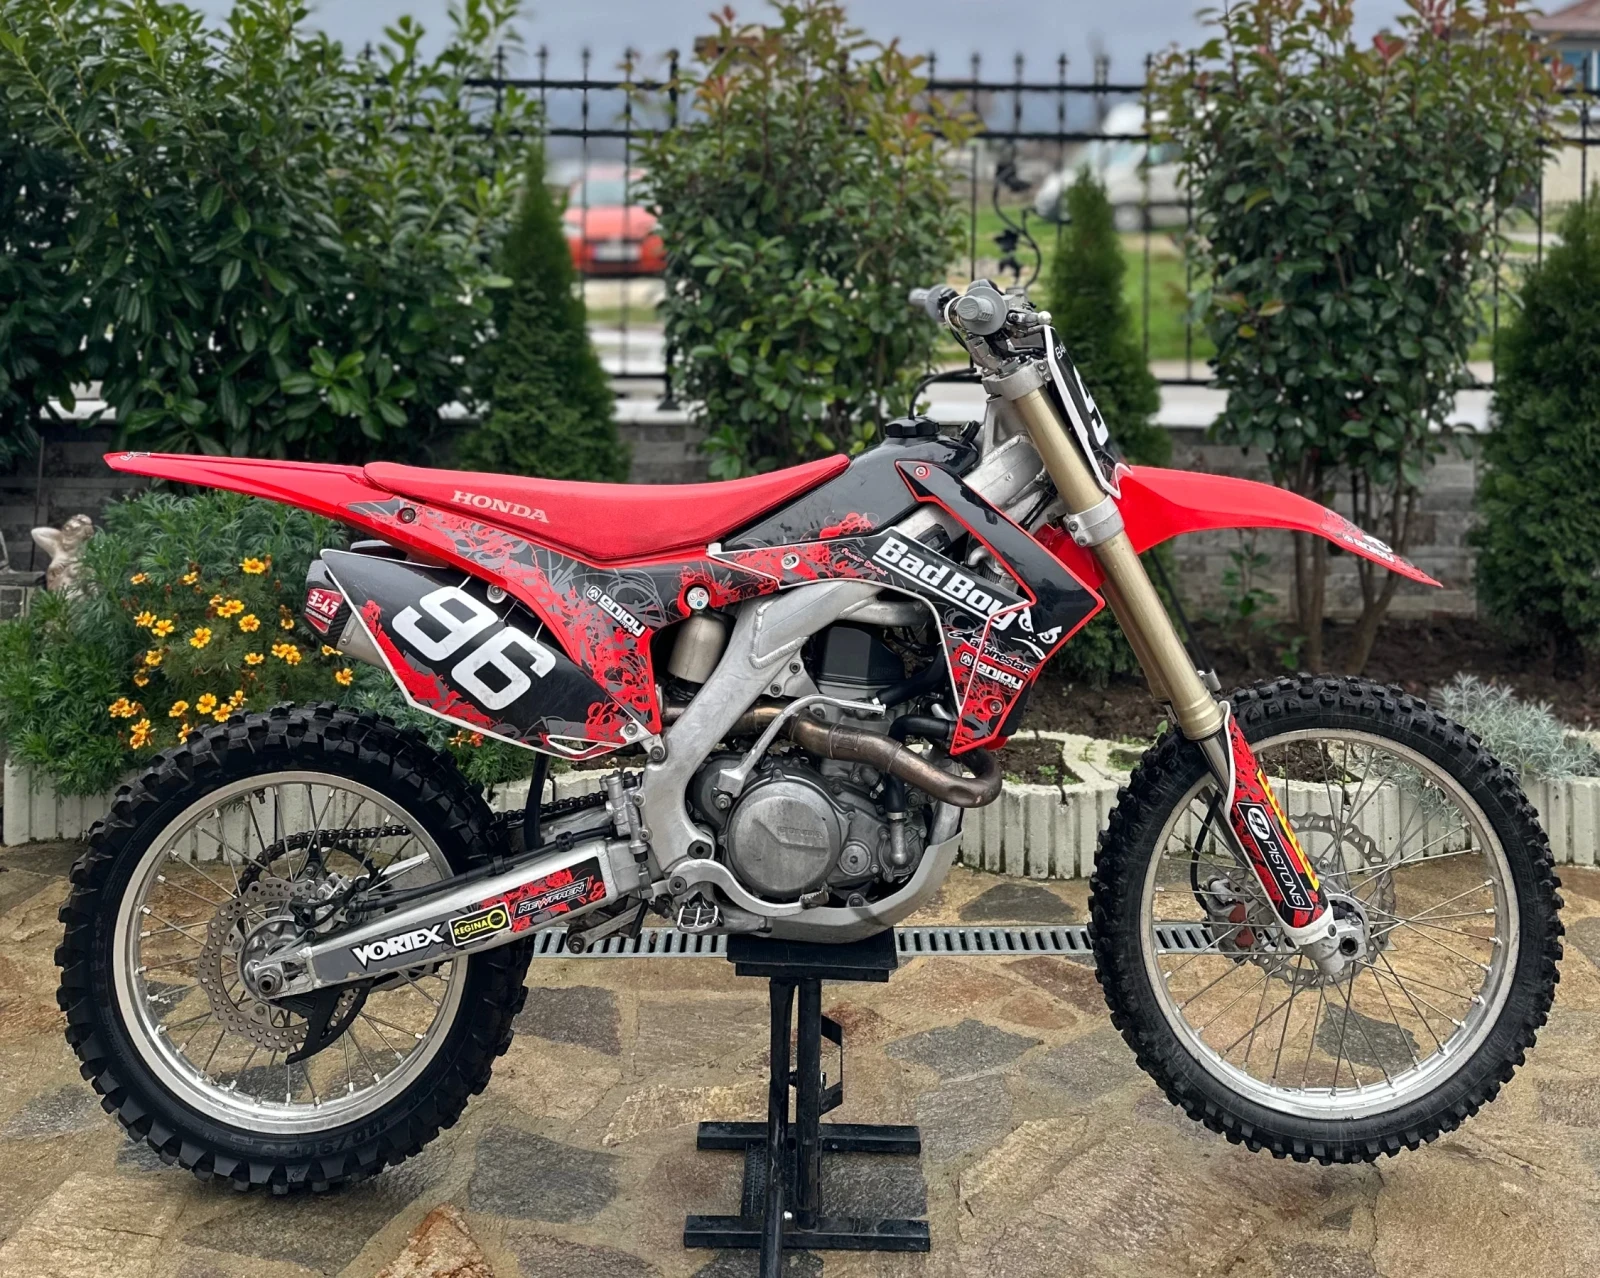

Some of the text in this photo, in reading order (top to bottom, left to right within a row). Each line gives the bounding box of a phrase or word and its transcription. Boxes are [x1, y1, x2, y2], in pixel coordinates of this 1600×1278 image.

[451, 490, 550, 524] HONDA
[875, 536, 1018, 631] Bad Boy
[597, 594, 646, 637] enjoy
[391, 586, 556, 711] 96
[975, 661, 1024, 690] enjoy
[1263, 840, 1306, 907] PISTONS
[352, 923, 445, 967] VORTEX
[453, 920, 489, 937] REGINA
